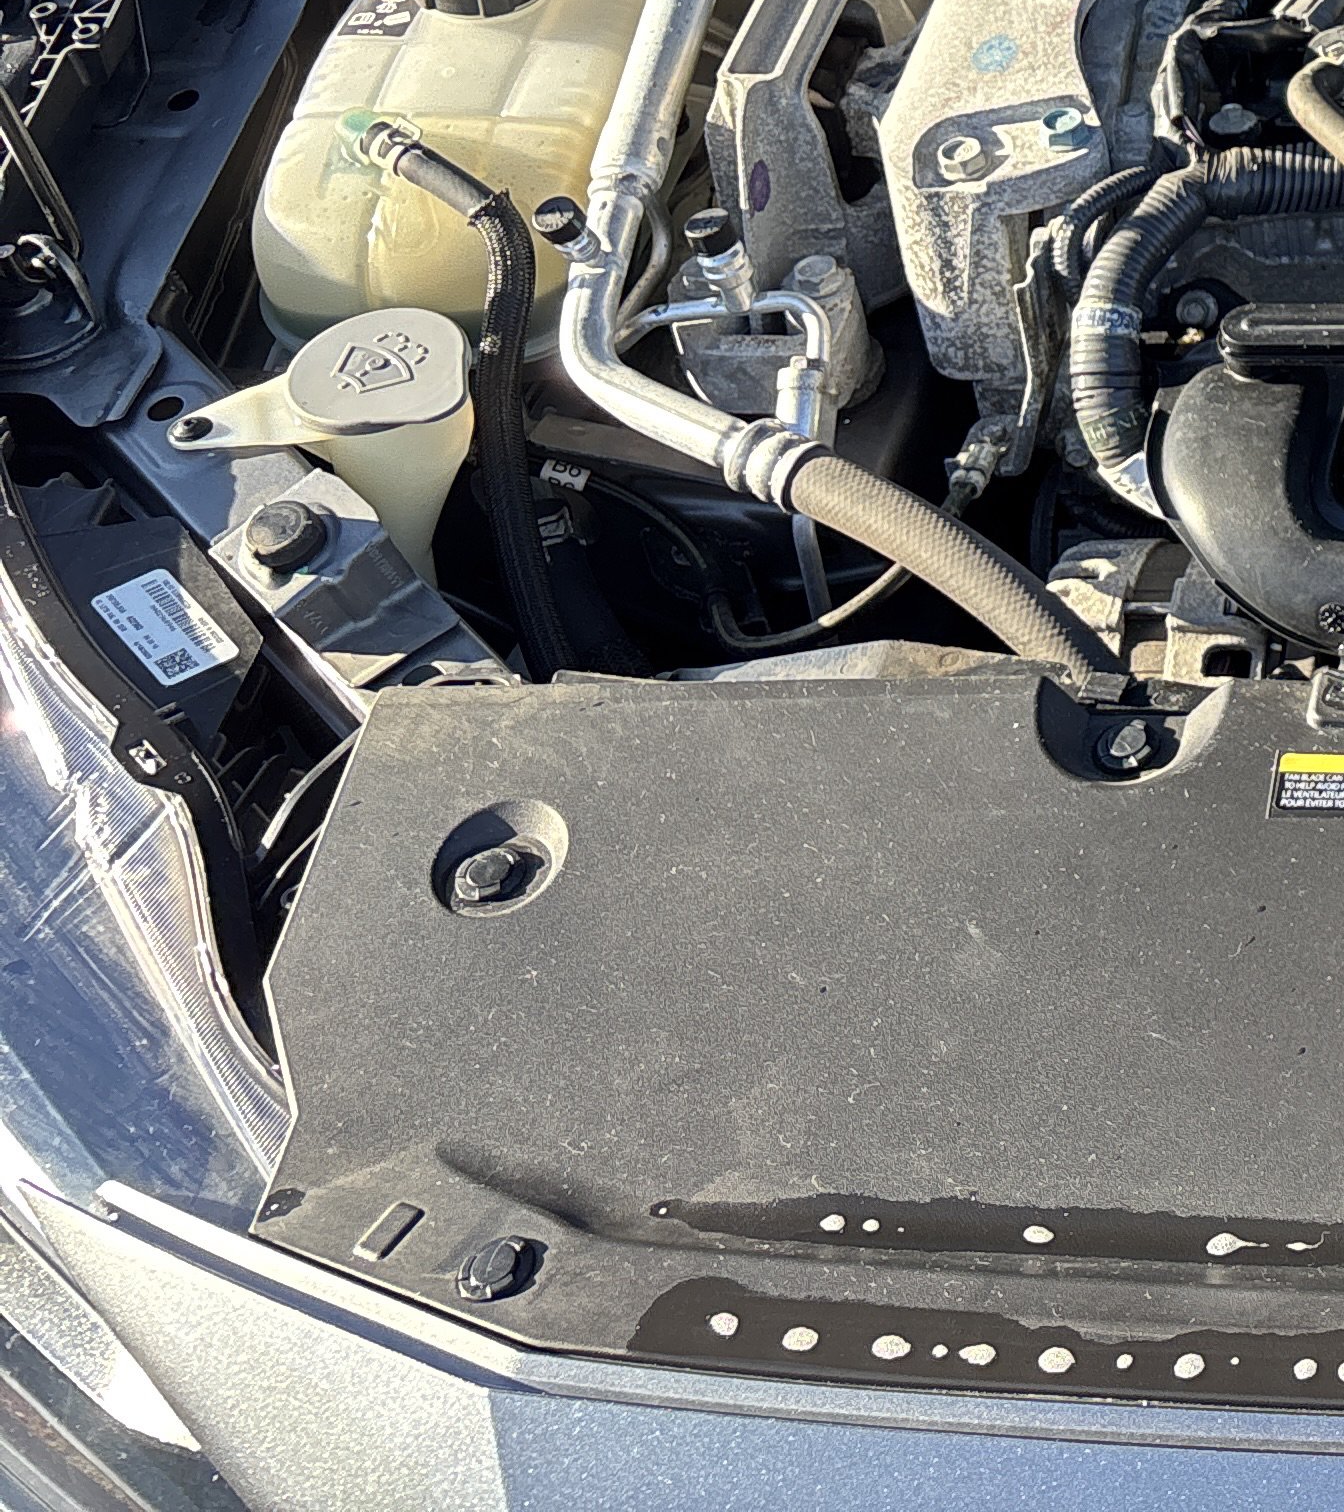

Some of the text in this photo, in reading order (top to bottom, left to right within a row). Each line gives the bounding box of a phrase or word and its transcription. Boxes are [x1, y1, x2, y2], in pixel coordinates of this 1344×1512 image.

[1284, 773, 1300, 781] FAN
[1301, 773, 1325, 782] BLADE
[1326, 774, 1343, 782] CAN
[1284, 781, 1295, 789] TO
[1296, 781, 1315, 790] HELP
[1316, 782, 1340, 790] AVOID
[1281, 790, 1291, 798] LE
[1280, 798, 1304, 807] POUR
